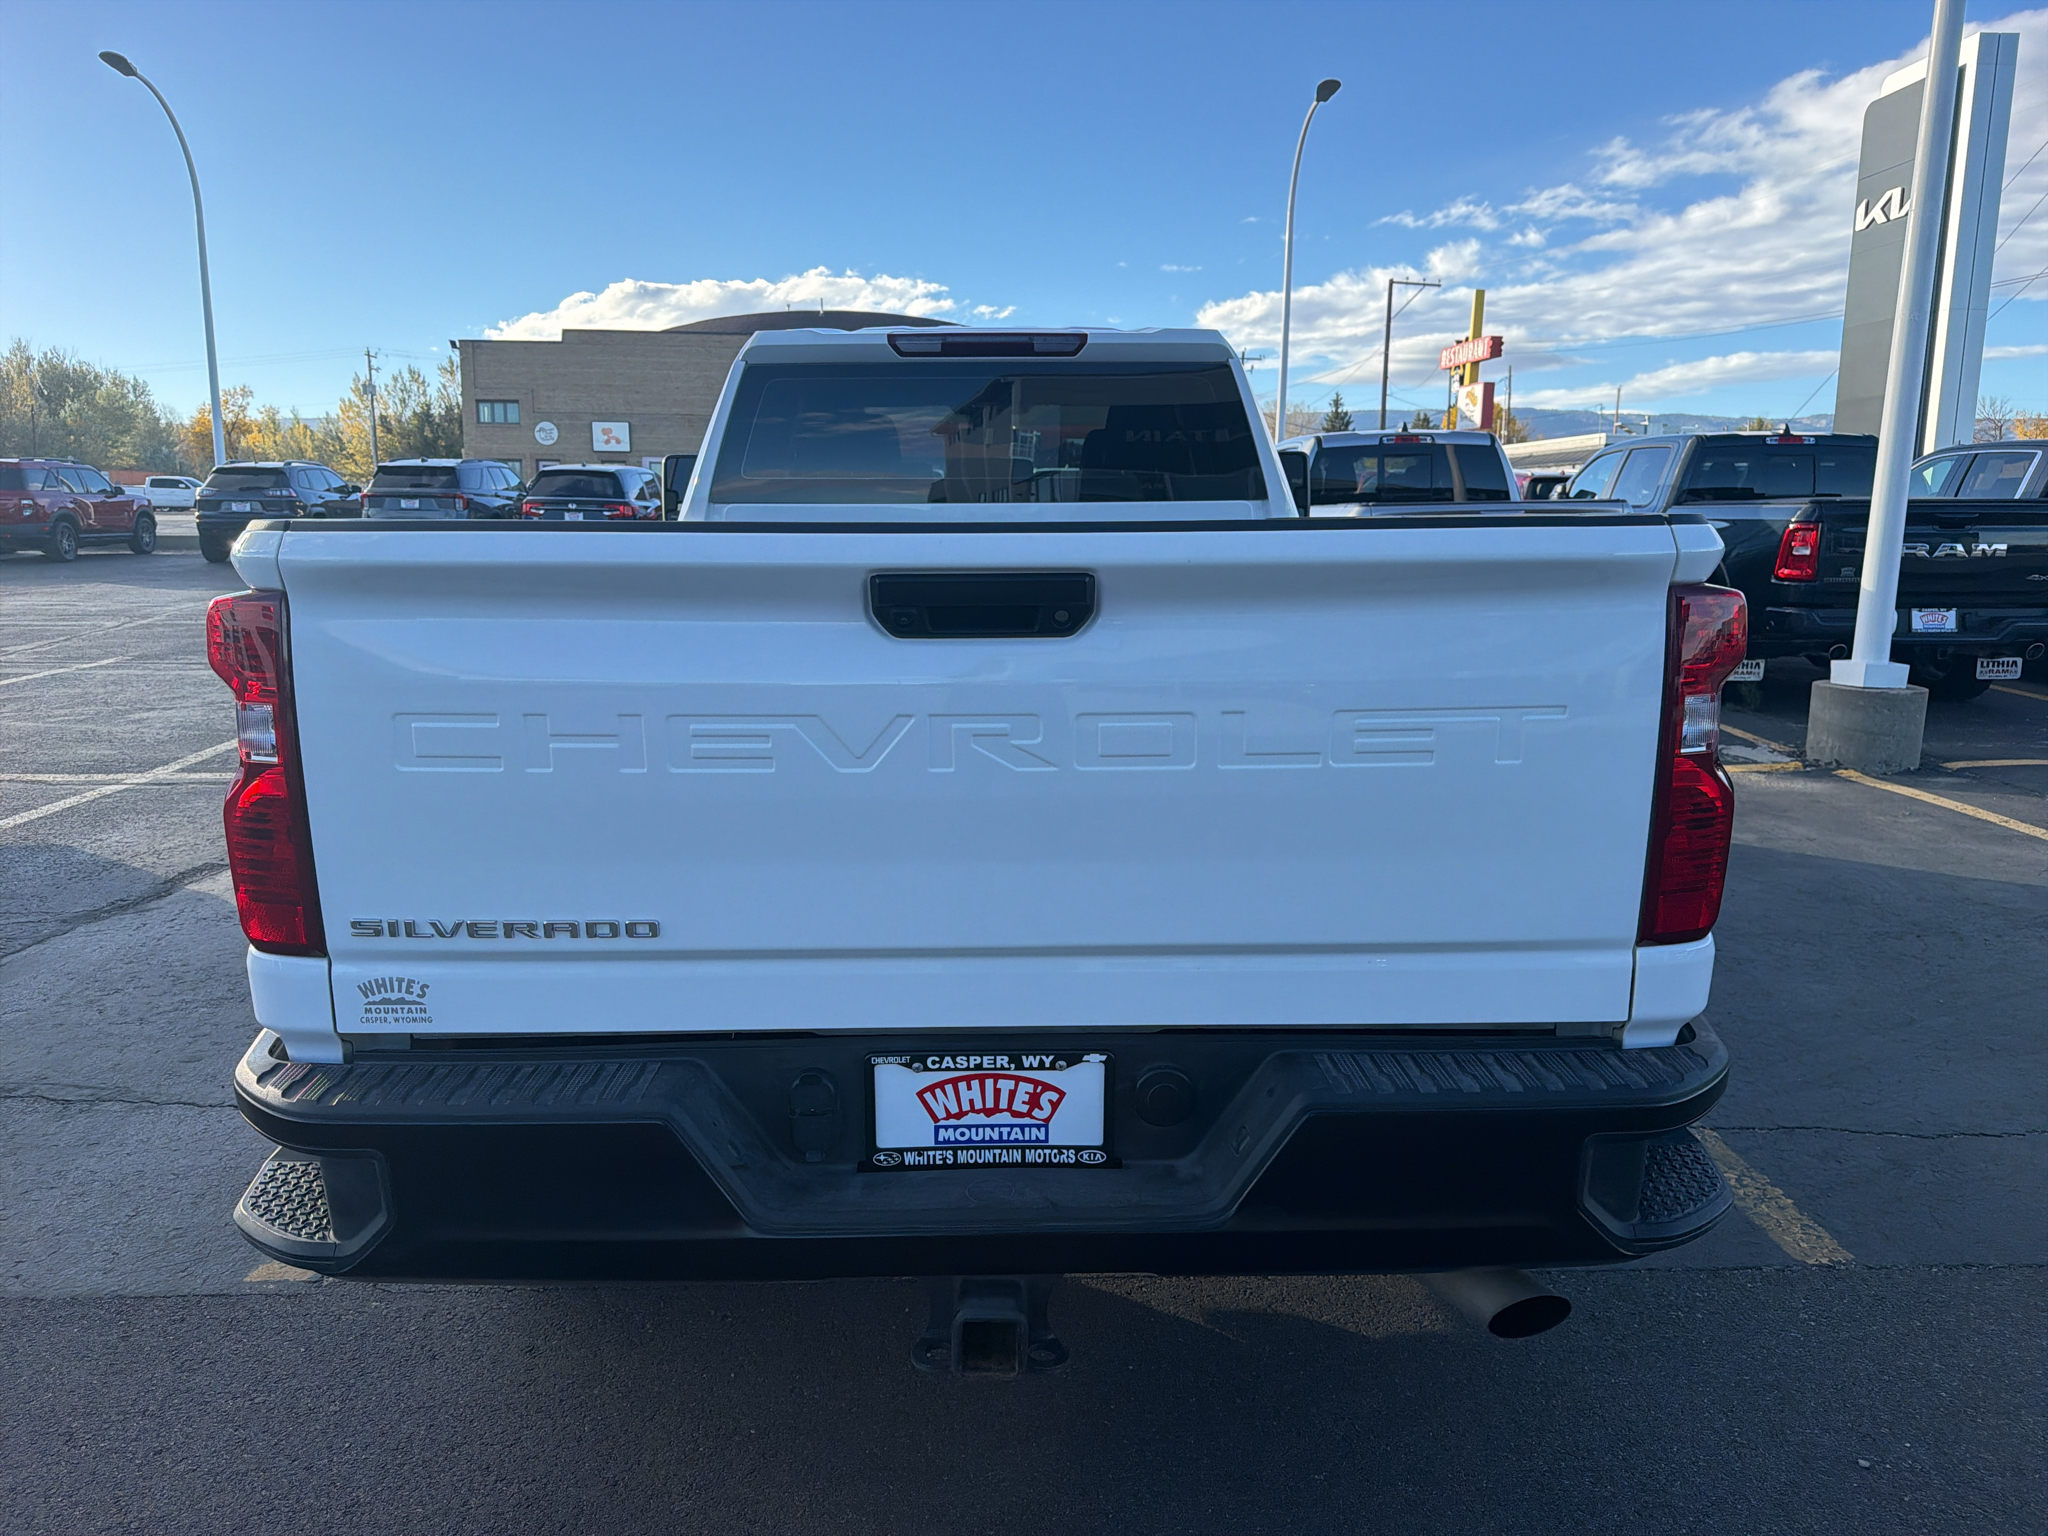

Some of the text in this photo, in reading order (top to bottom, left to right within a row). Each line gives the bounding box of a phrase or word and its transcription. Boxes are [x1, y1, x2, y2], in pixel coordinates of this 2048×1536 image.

[1441, 338, 1490, 367] RESTAURANT
[1901, 543, 2008, 558] RAM
[1980, 660, 2018, 668] LITHIA
[392, 705, 1568, 774] CHEVROLET
[350, 917, 661, 940] SILVERADO
[356, 976, 431, 999] WHITE'S
[360, 1016, 392, 1024] CASPER,
[871, 1056, 911, 1064] CHEVROLET
[926, 1055, 1055, 1071] CASPER, WY
[922, 1078, 1060, 1120] WHITE'S
[938, 1127, 1046, 1141] MOUNTAIN
[903, 1149, 1076, 1165] WHITE'S MOUNTAIN MOTORS
[1082, 1153, 1101, 1161] KIA
